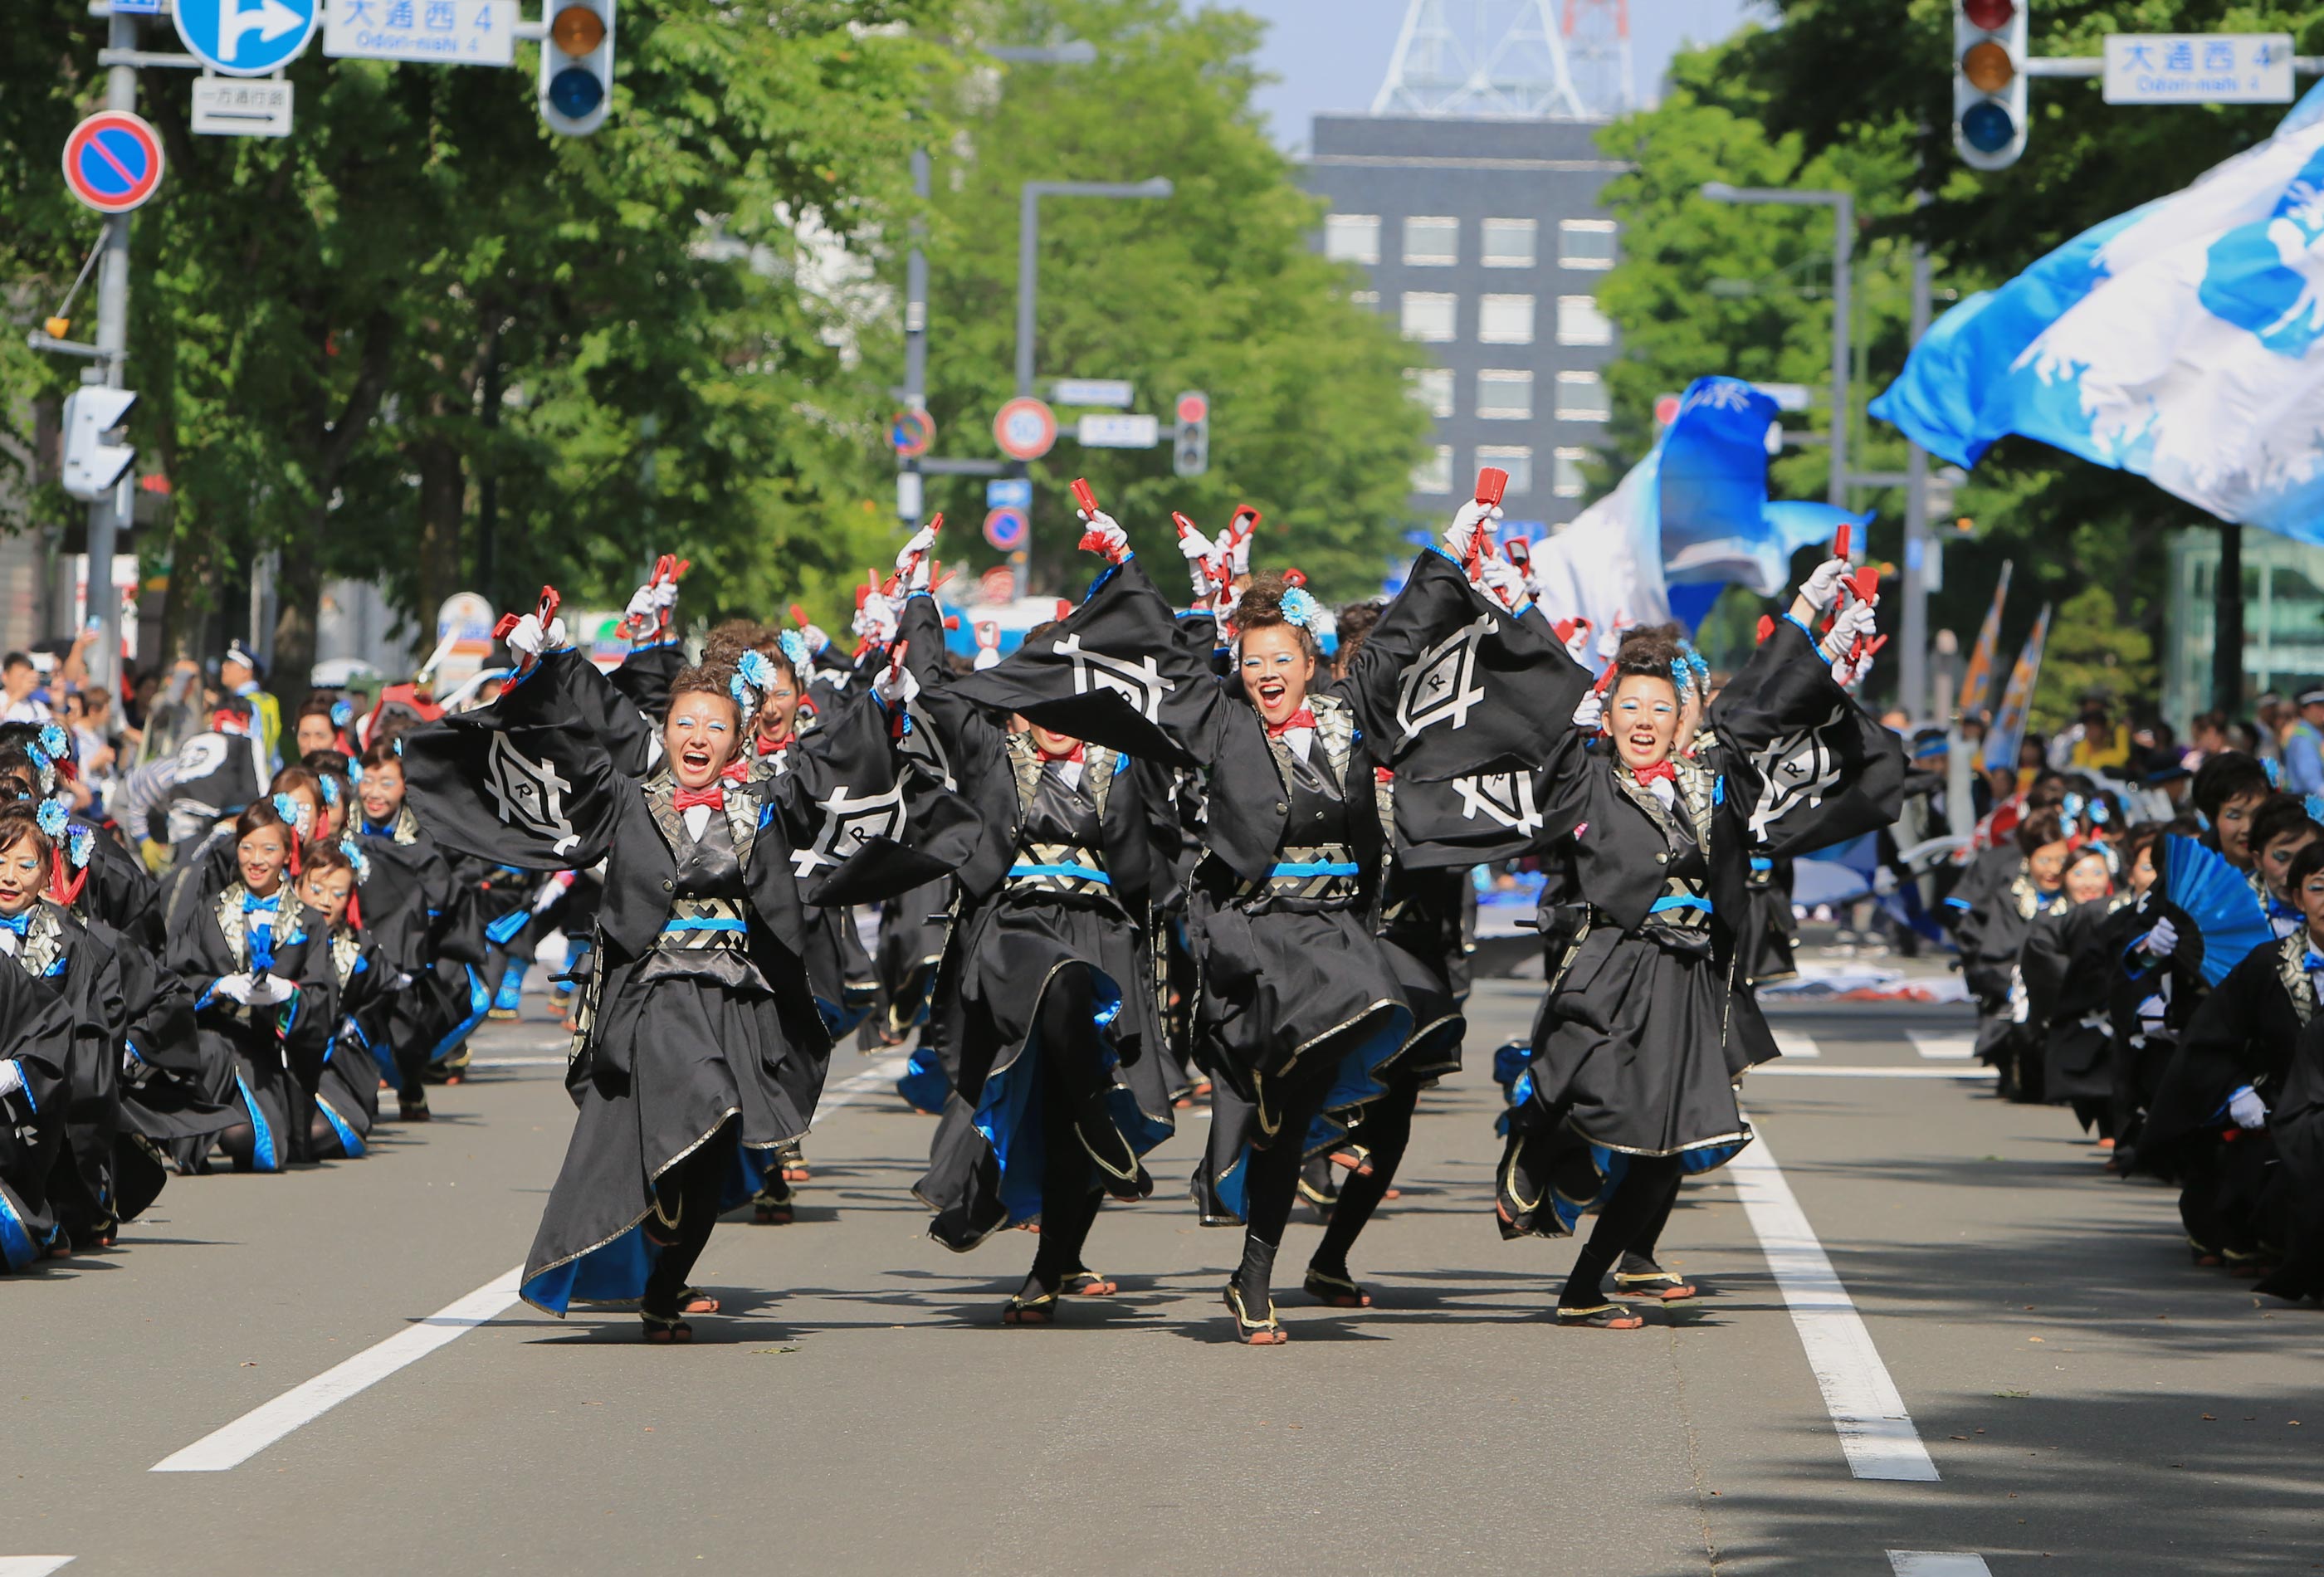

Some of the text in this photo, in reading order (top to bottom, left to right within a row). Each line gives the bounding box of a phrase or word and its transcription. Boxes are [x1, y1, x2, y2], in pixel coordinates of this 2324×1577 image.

[343, 0, 492, 32] 大通西 4
[2121, 40, 2272, 73] 大通西 4
[1428, 673, 1446, 692] R
[1783, 761, 1805, 779] R
[515, 783, 534, 799] R
[849, 826, 872, 846] R
